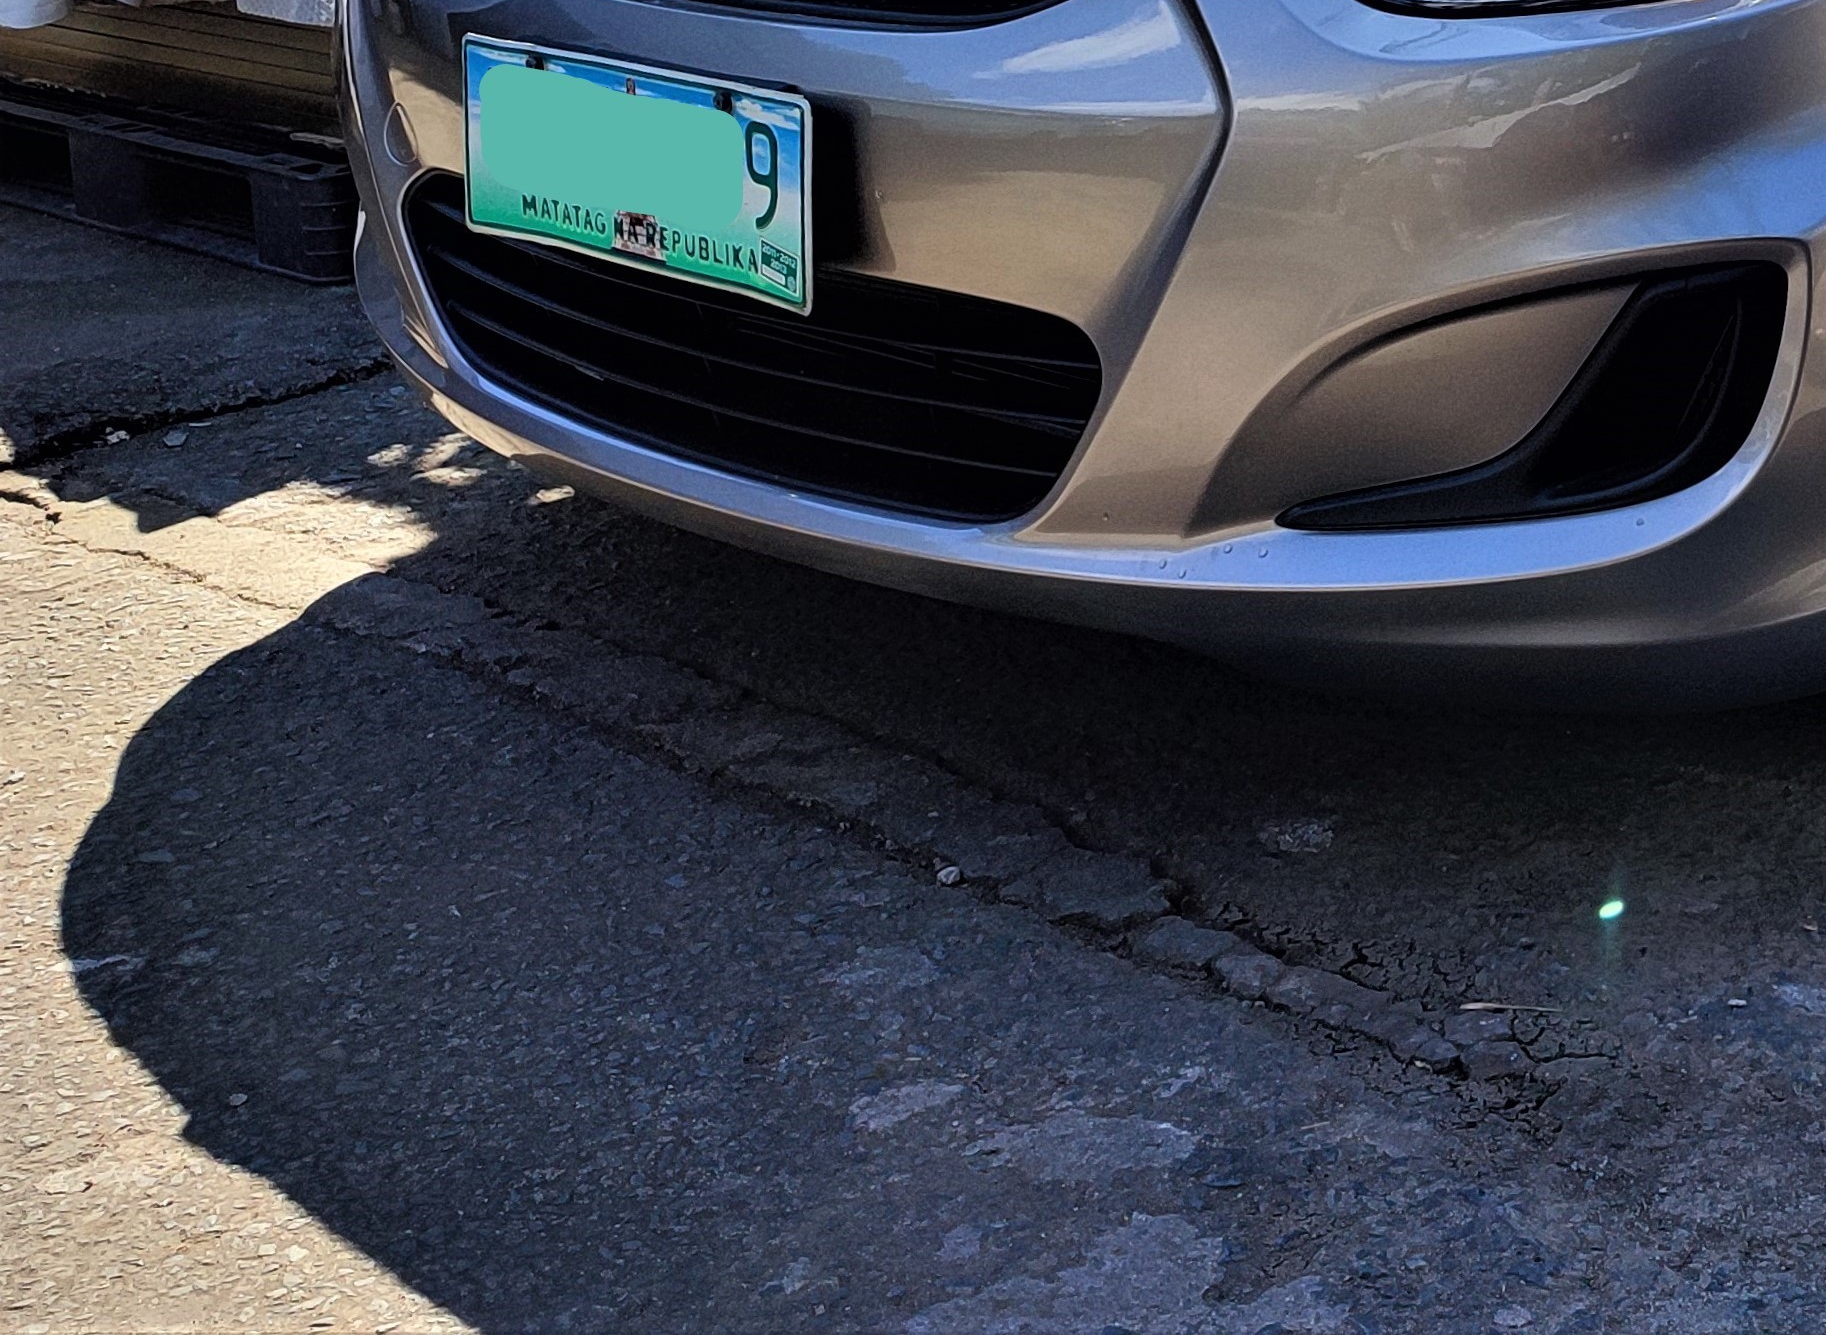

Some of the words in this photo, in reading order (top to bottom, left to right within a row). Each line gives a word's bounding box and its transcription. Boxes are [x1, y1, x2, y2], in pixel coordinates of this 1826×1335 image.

[522, 193, 607, 235] MATATAG
[614, 216, 639, 243] NA
[645, 222, 760, 275] REPUBLIKA
